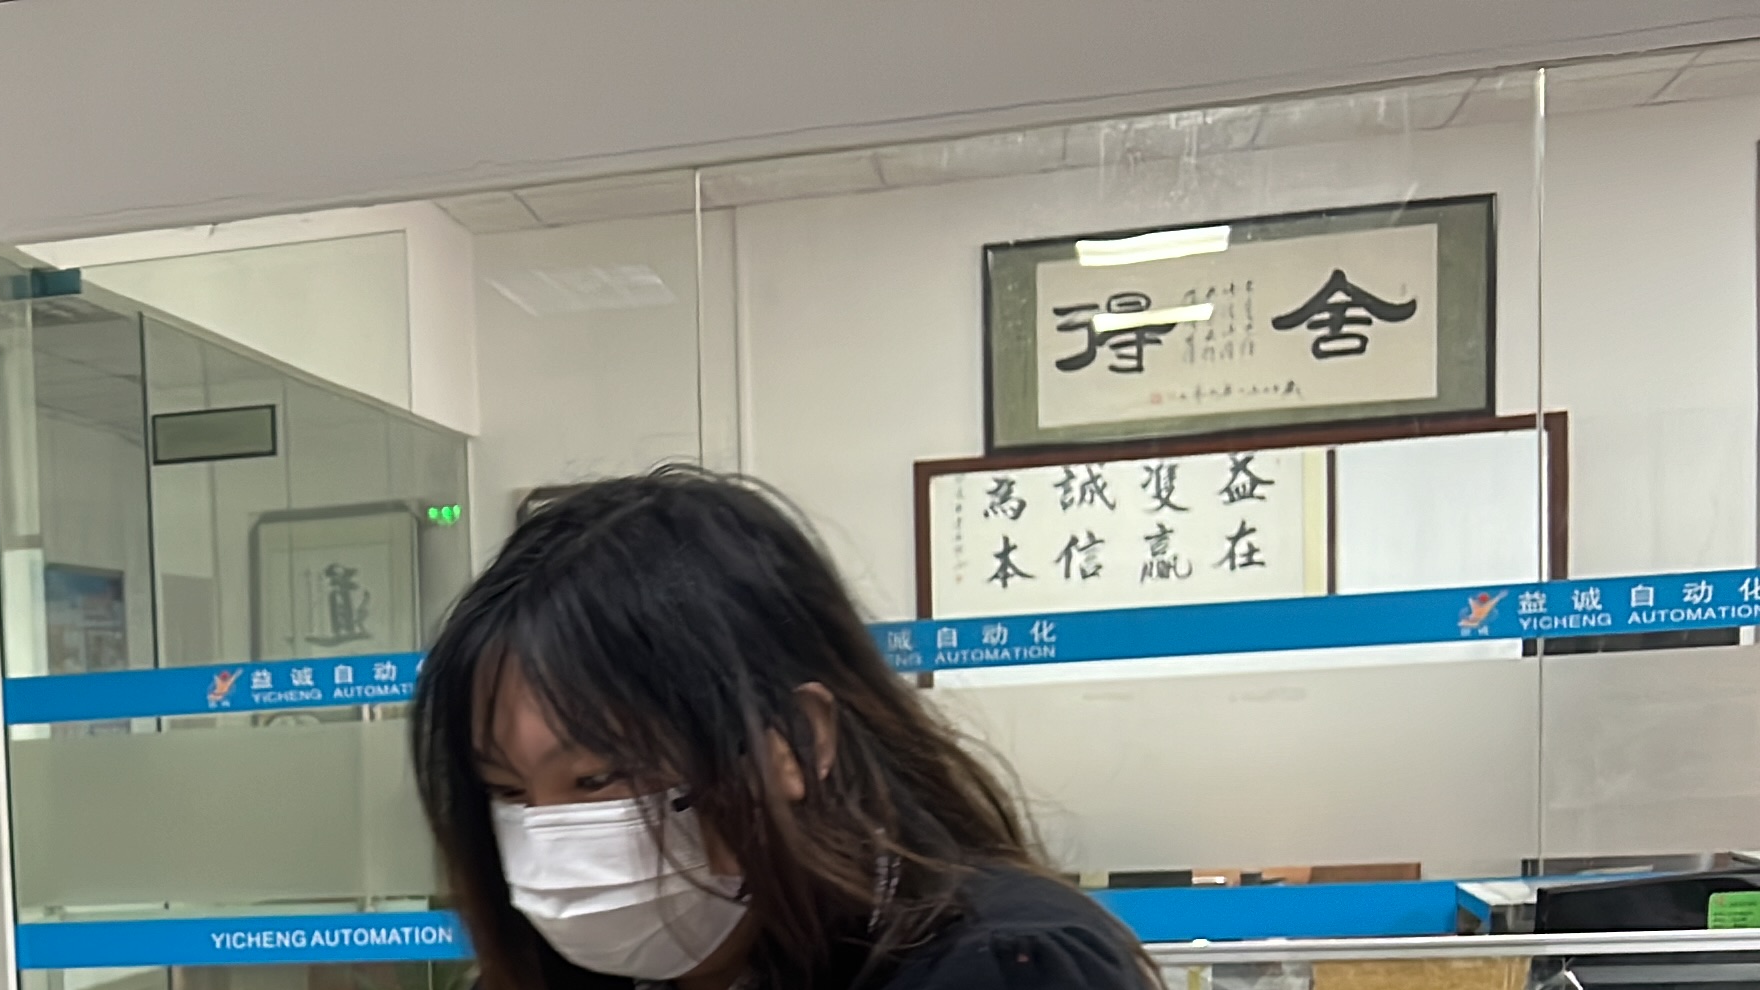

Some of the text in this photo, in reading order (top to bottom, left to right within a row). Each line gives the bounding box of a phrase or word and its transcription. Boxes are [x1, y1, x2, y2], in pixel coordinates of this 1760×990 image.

[1518, 578, 1760, 615] 益诚自动化
[1519, 612, 1612, 631] YICHENG
[887, 620, 1057, 651] 诚自动化
[934, 645, 1056, 665] AUTOMATION
[250, 658, 424, 689] 益诚自动
[251, 687, 322, 704] YICHENG
[210, 926, 453, 949] YICHENG AUTOMATION
